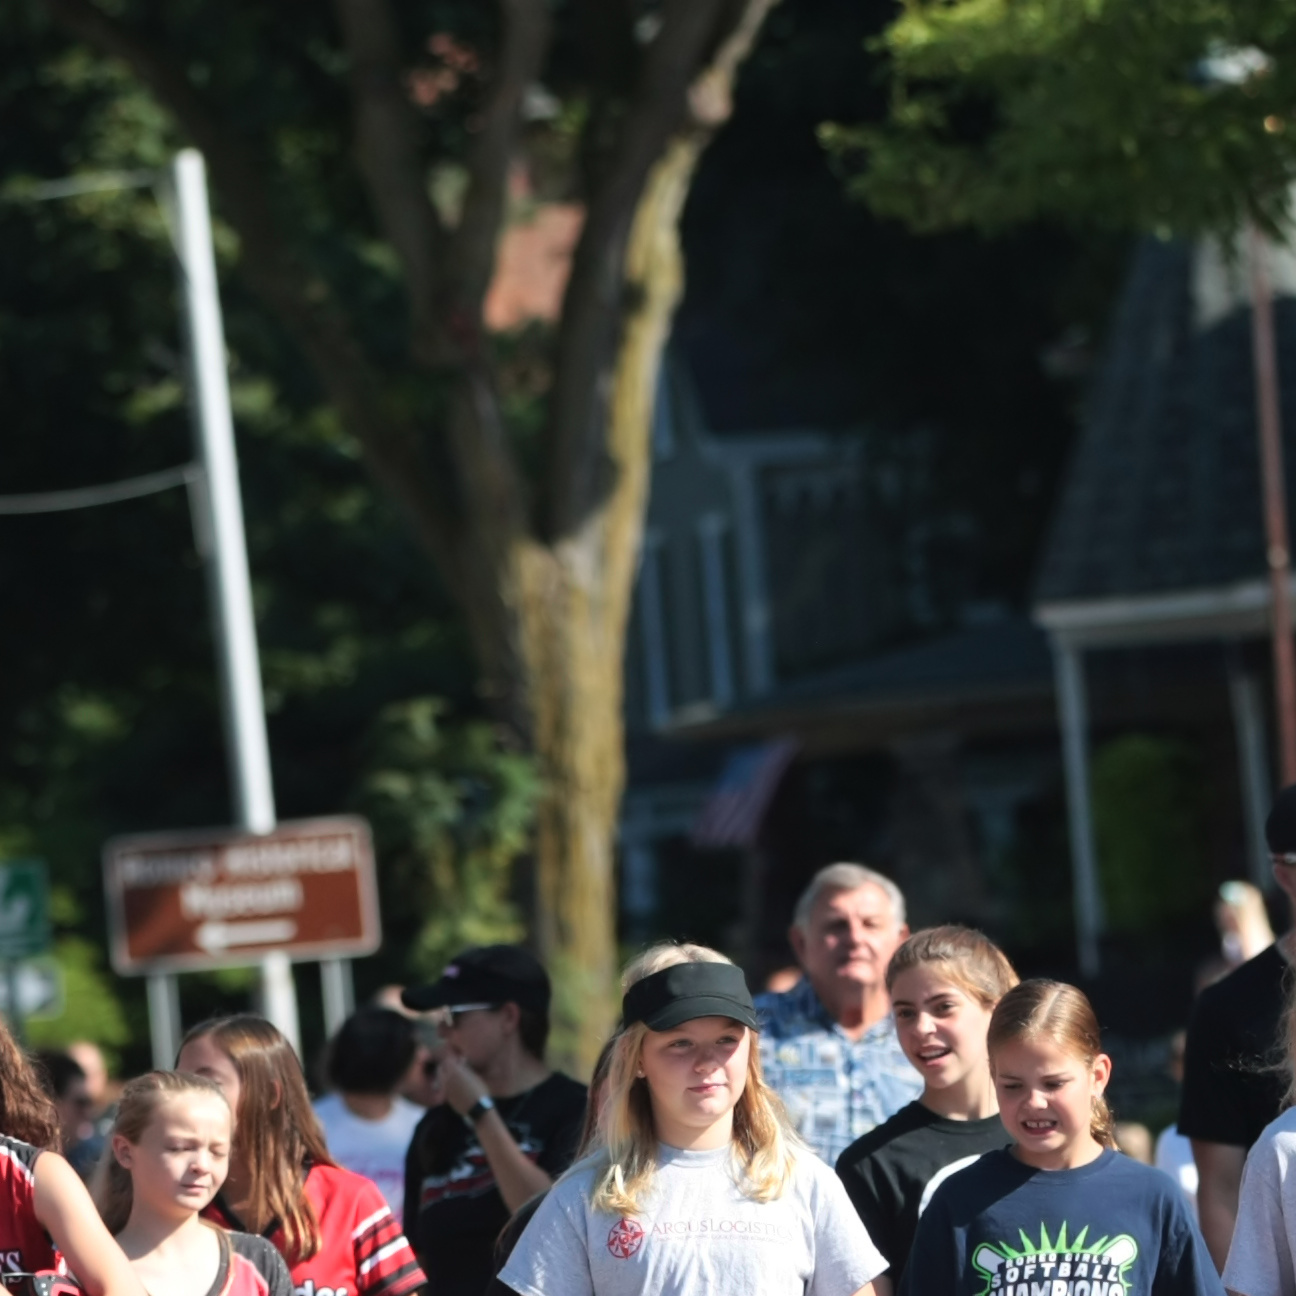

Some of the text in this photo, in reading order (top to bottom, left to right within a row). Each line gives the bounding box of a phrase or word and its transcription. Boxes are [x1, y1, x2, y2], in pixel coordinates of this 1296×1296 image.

[1006, 1253, 1111, 1269] ROMEO GIRLS
[991, 1261, 1120, 1289] SOFTBALL
